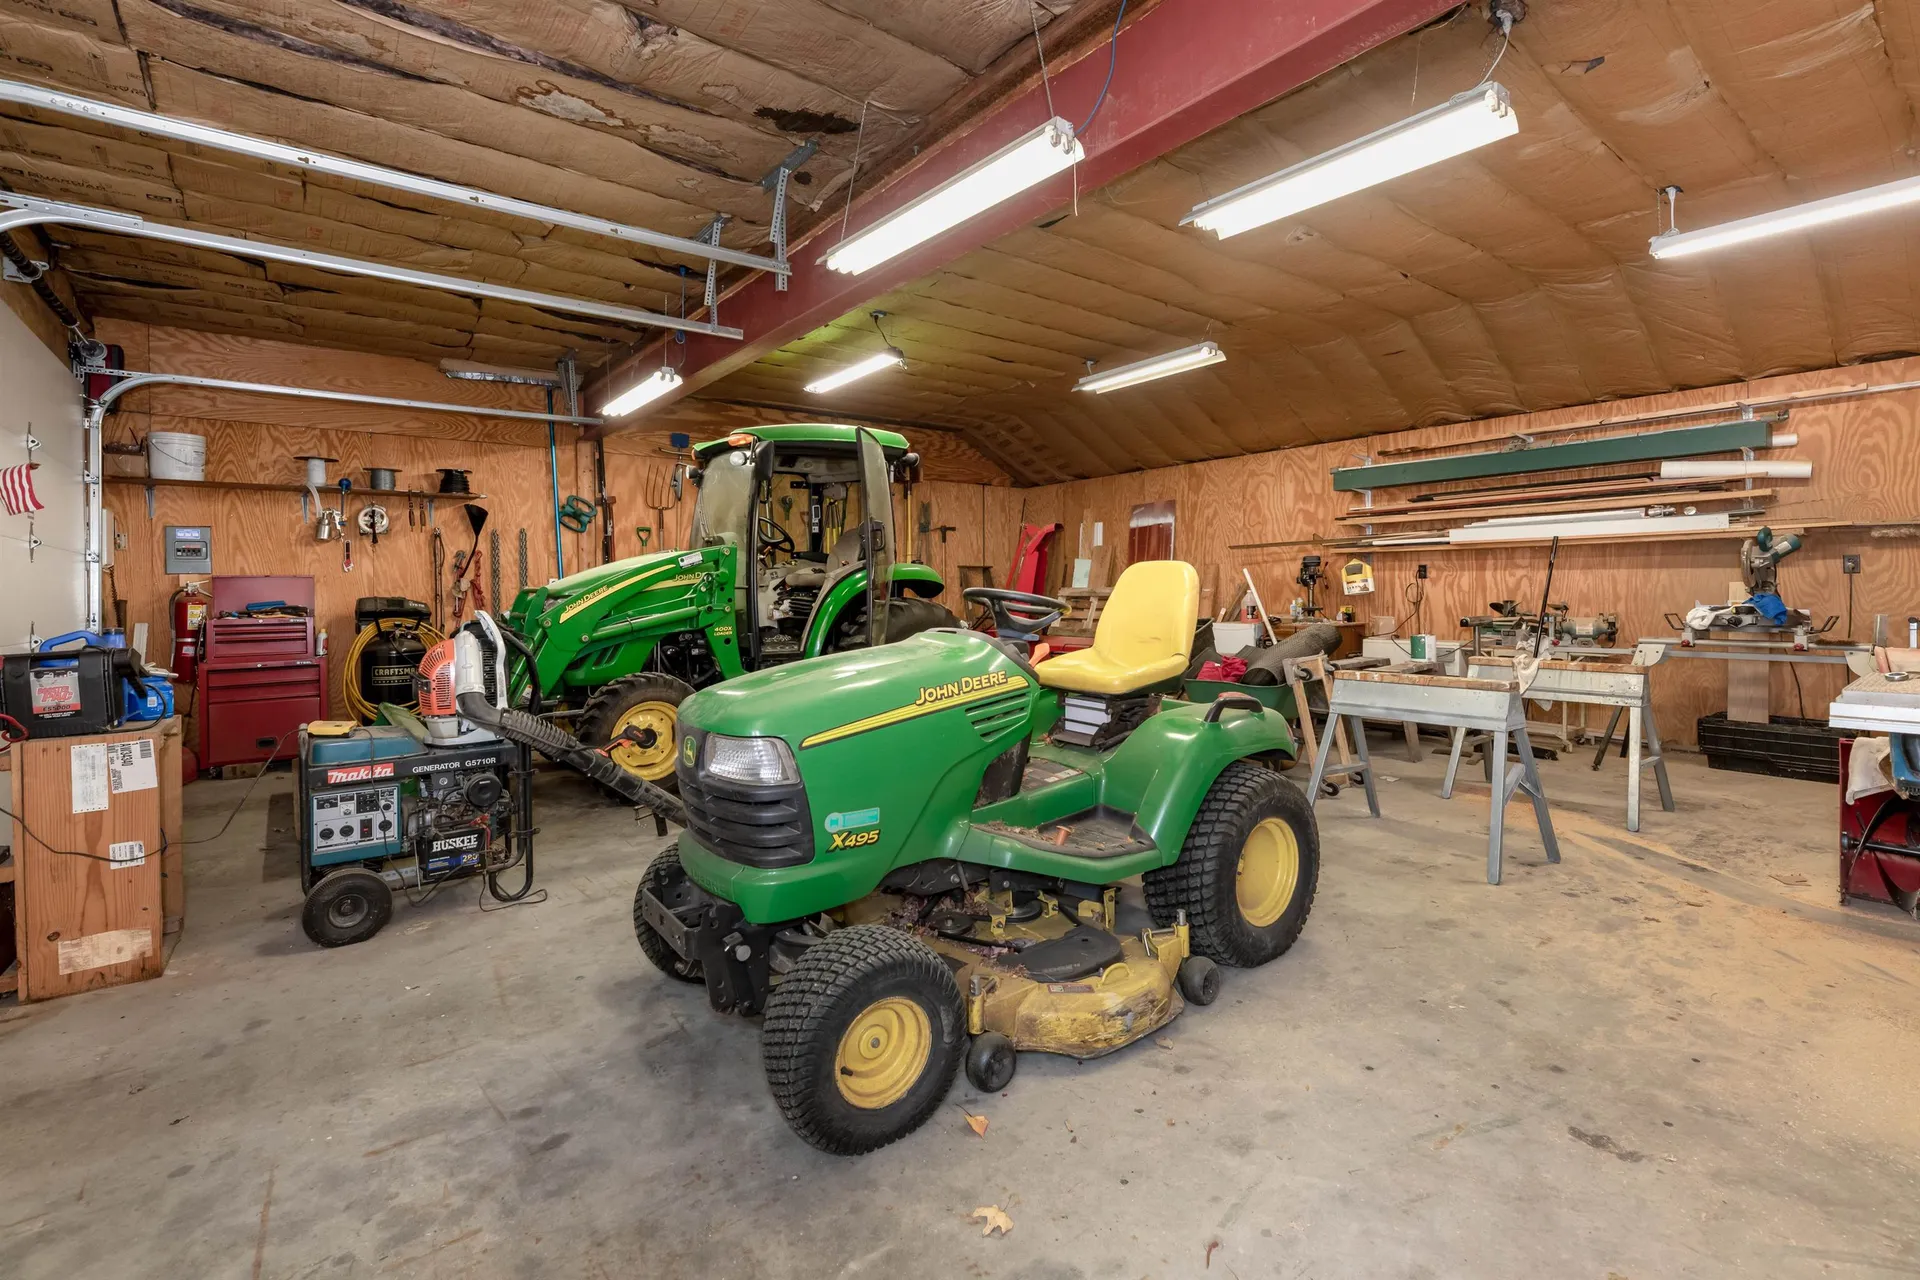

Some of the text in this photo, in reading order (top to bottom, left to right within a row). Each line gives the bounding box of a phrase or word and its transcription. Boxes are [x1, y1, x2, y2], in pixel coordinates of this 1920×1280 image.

[673, 573, 695, 582] JOHN
[564, 584, 609, 613] JOHN DEERE
[374, 667, 417, 676] CRAFTSMA
[916, 670, 1008, 706] JOHN DEERE
[412, 757, 497, 774] GENERATOR G5710R
[431, 833, 479, 853] HUSKEE
[826, 829, 880, 853] X495
